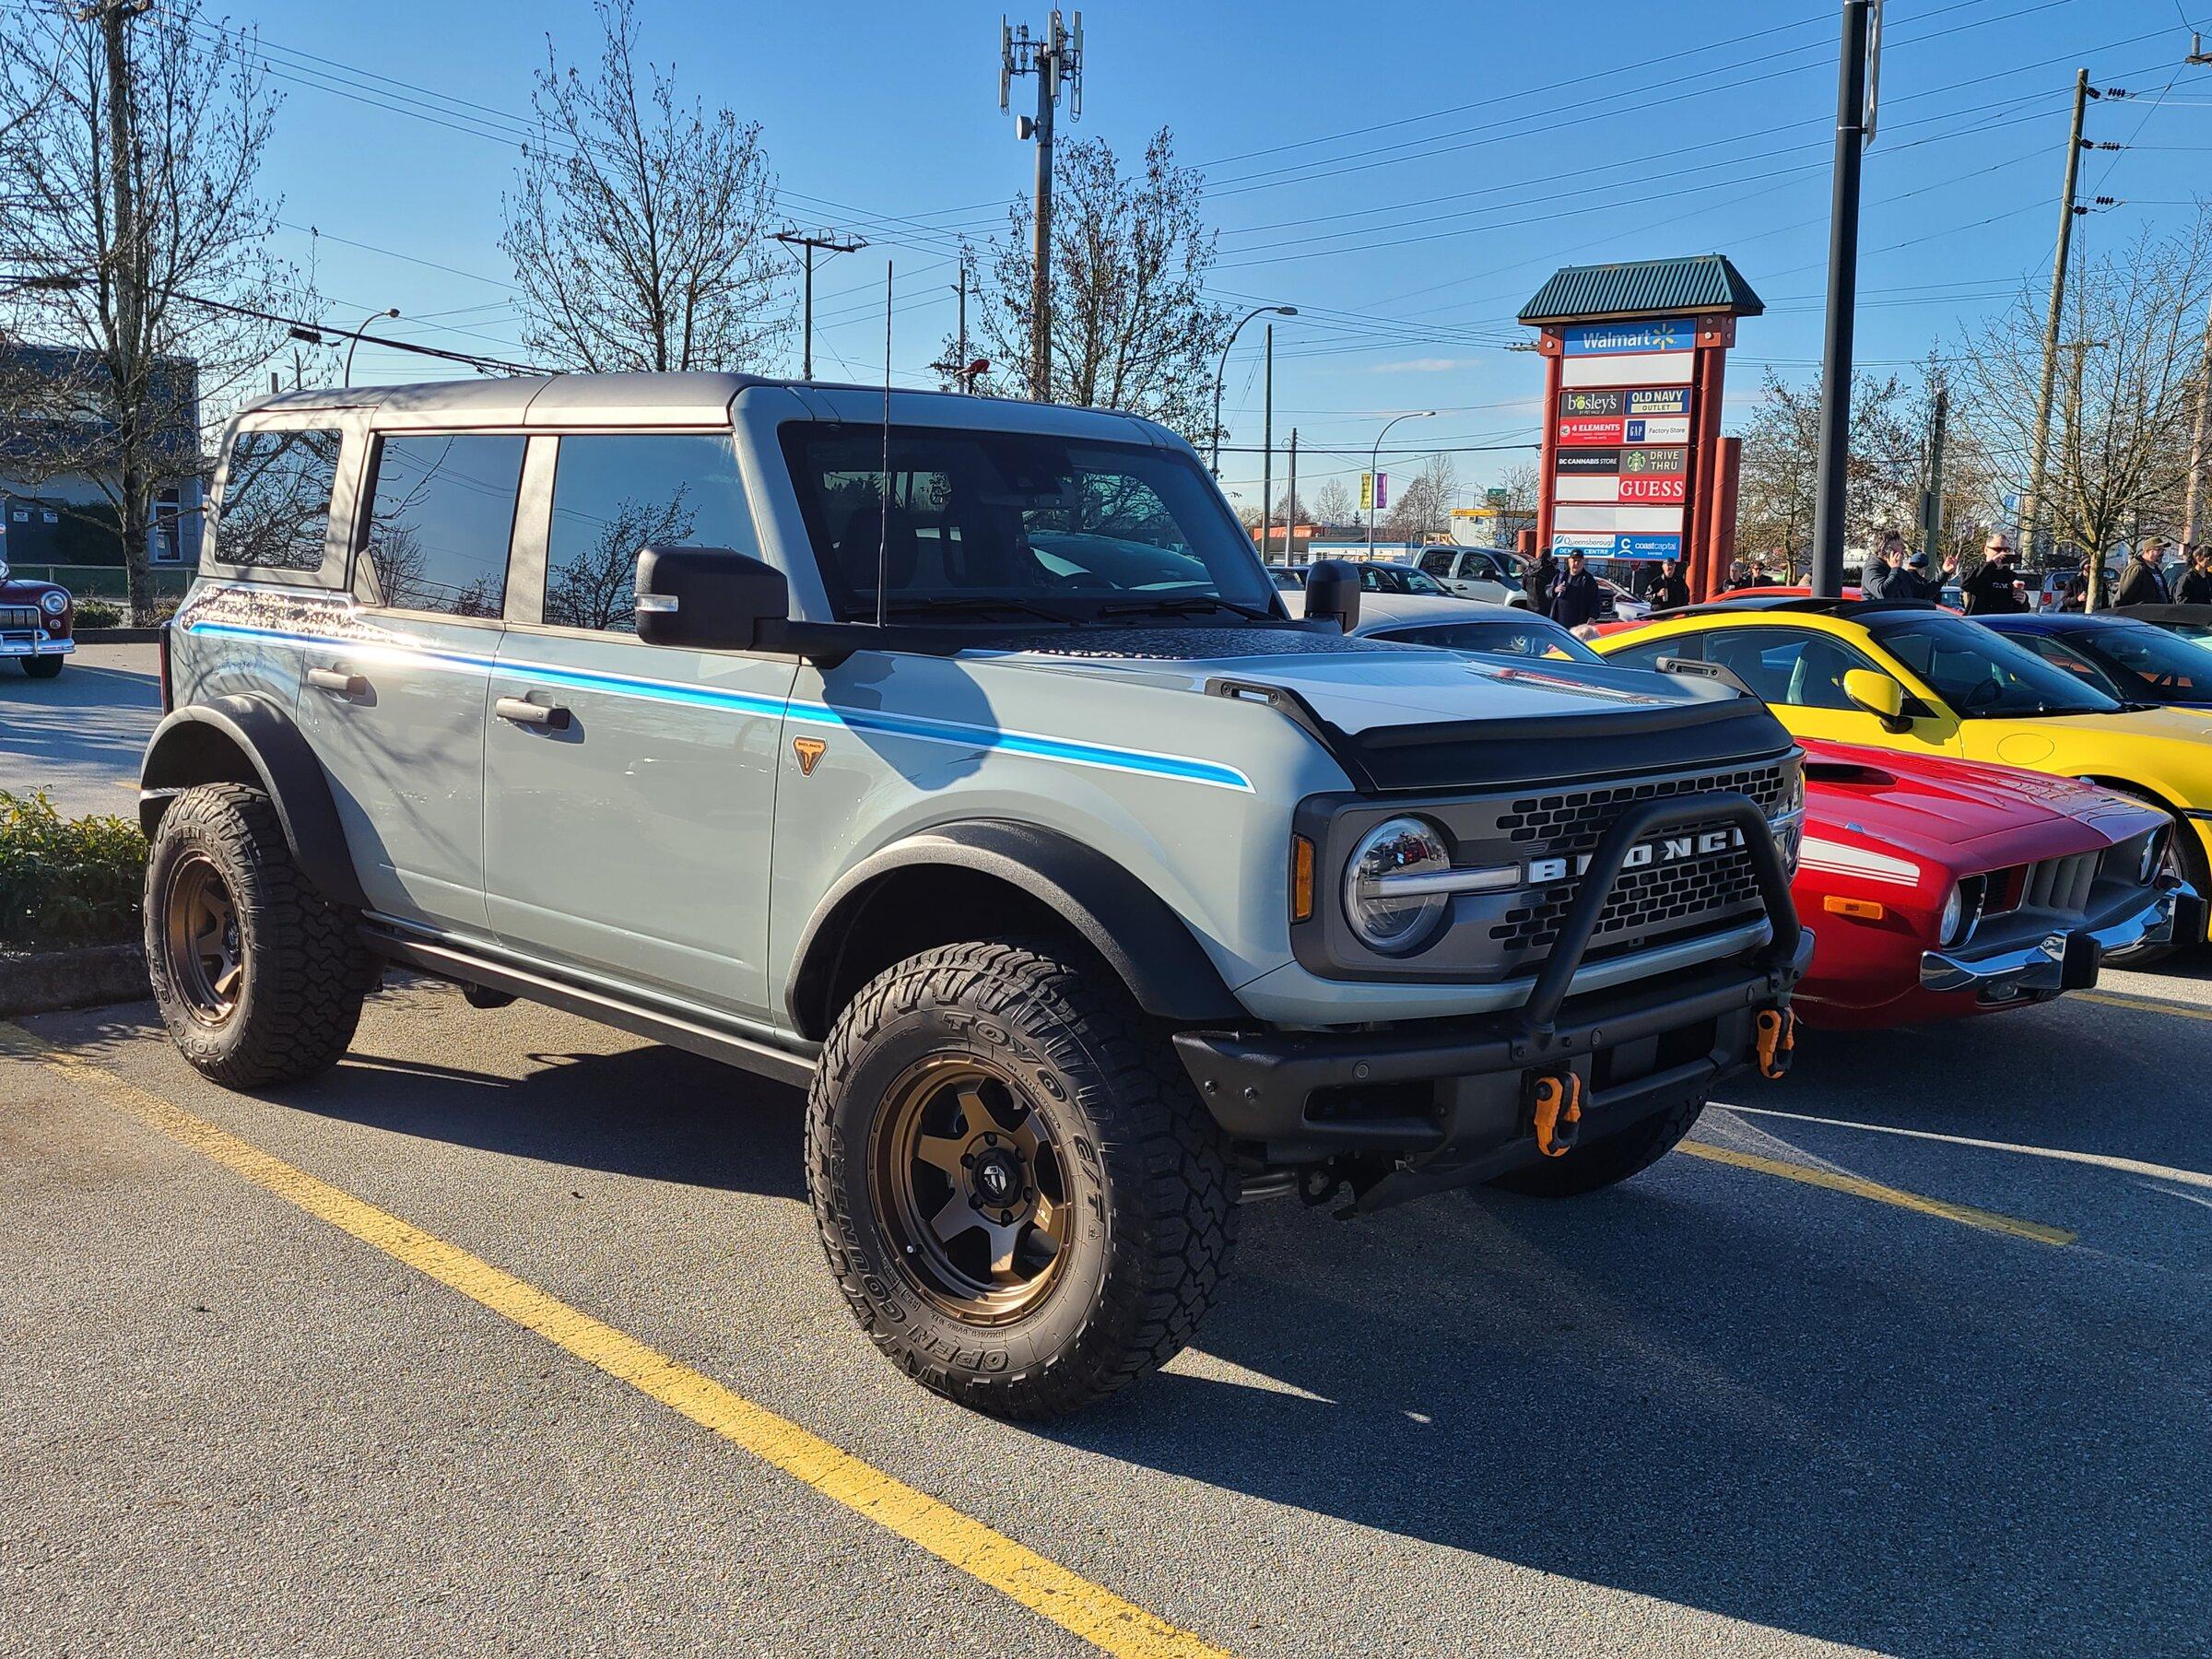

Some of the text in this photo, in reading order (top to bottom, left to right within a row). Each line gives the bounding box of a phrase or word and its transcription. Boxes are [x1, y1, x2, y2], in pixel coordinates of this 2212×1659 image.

[1583, 329, 1651, 349] Walmart
[1631, 391, 1684, 403] OLD NAVY
[1568, 394, 1618, 415] bosley's
[1630, 426, 1642, 437] GAP
[1650, 451, 1679, 460] DRIVE
[1651, 461, 1677, 470] THRU
[1619, 480, 1684, 497] GUESS
[1563, 536, 1614, 547] Queensborough
[942, 1010, 1067, 1102] TOYO
[906, 1323, 1009, 1373] OPEN
